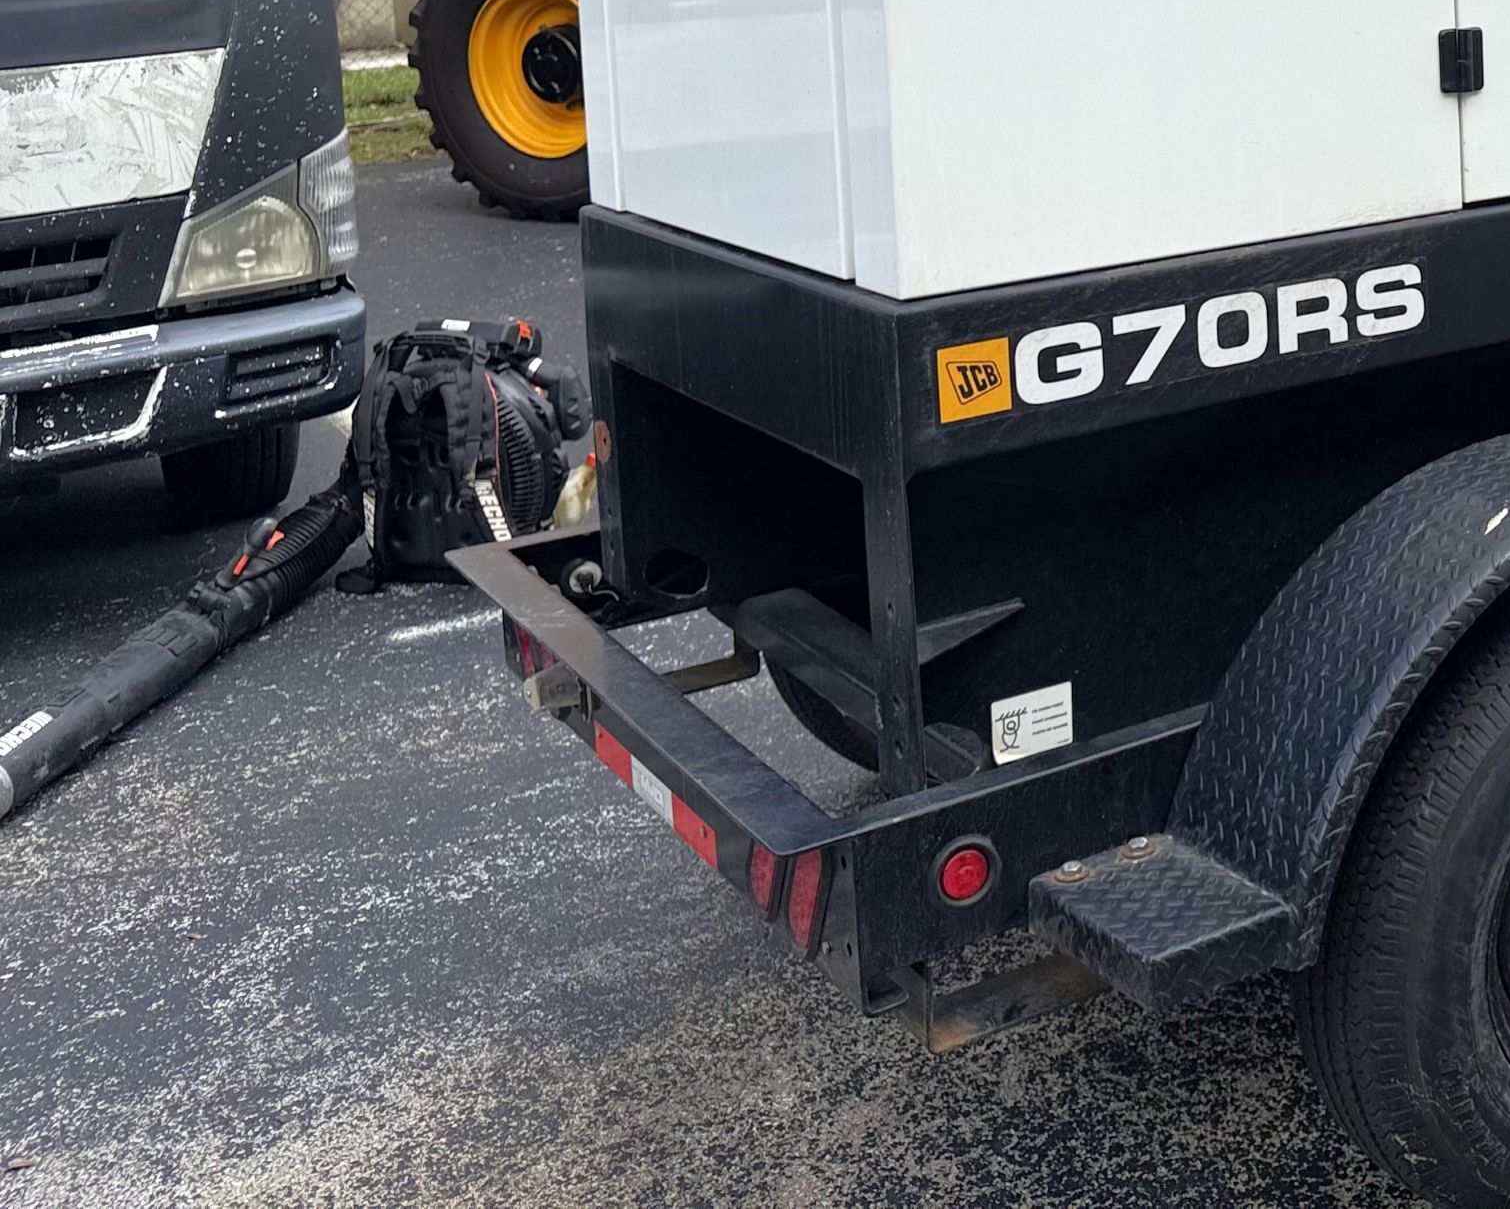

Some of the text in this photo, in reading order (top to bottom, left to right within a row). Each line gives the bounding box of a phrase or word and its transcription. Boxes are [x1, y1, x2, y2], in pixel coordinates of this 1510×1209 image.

[956, 262, 1426, 406] JCB G70RS
[479, 491, 513, 542] ECHO
